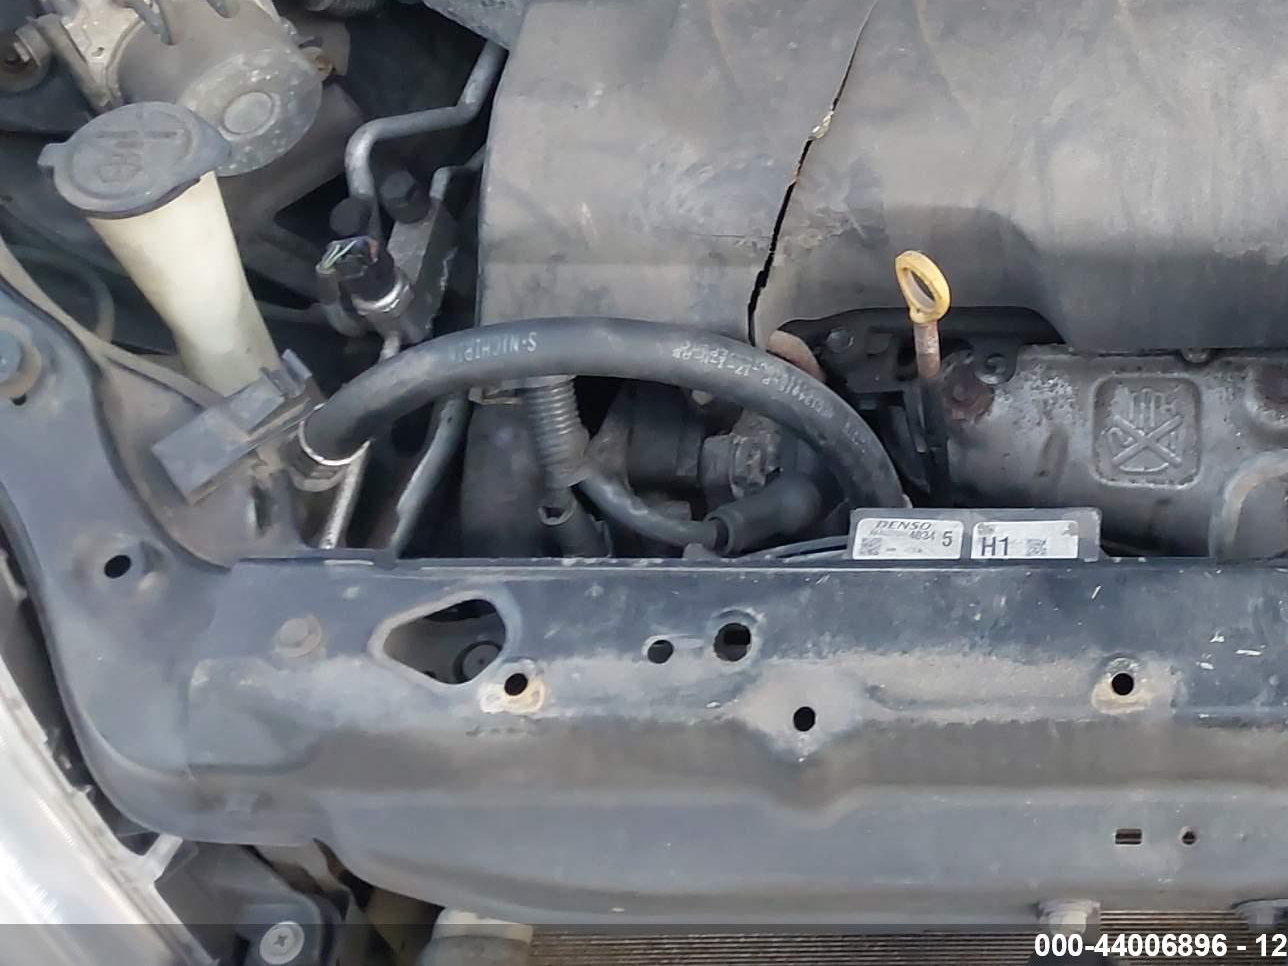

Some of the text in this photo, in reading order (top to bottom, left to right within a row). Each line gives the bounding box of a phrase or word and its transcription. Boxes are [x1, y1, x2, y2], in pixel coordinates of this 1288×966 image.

[875, 520, 932, 530] DENSO
[941, 530, 954, 547] 5
[981, 536, 1010, 556] H1
